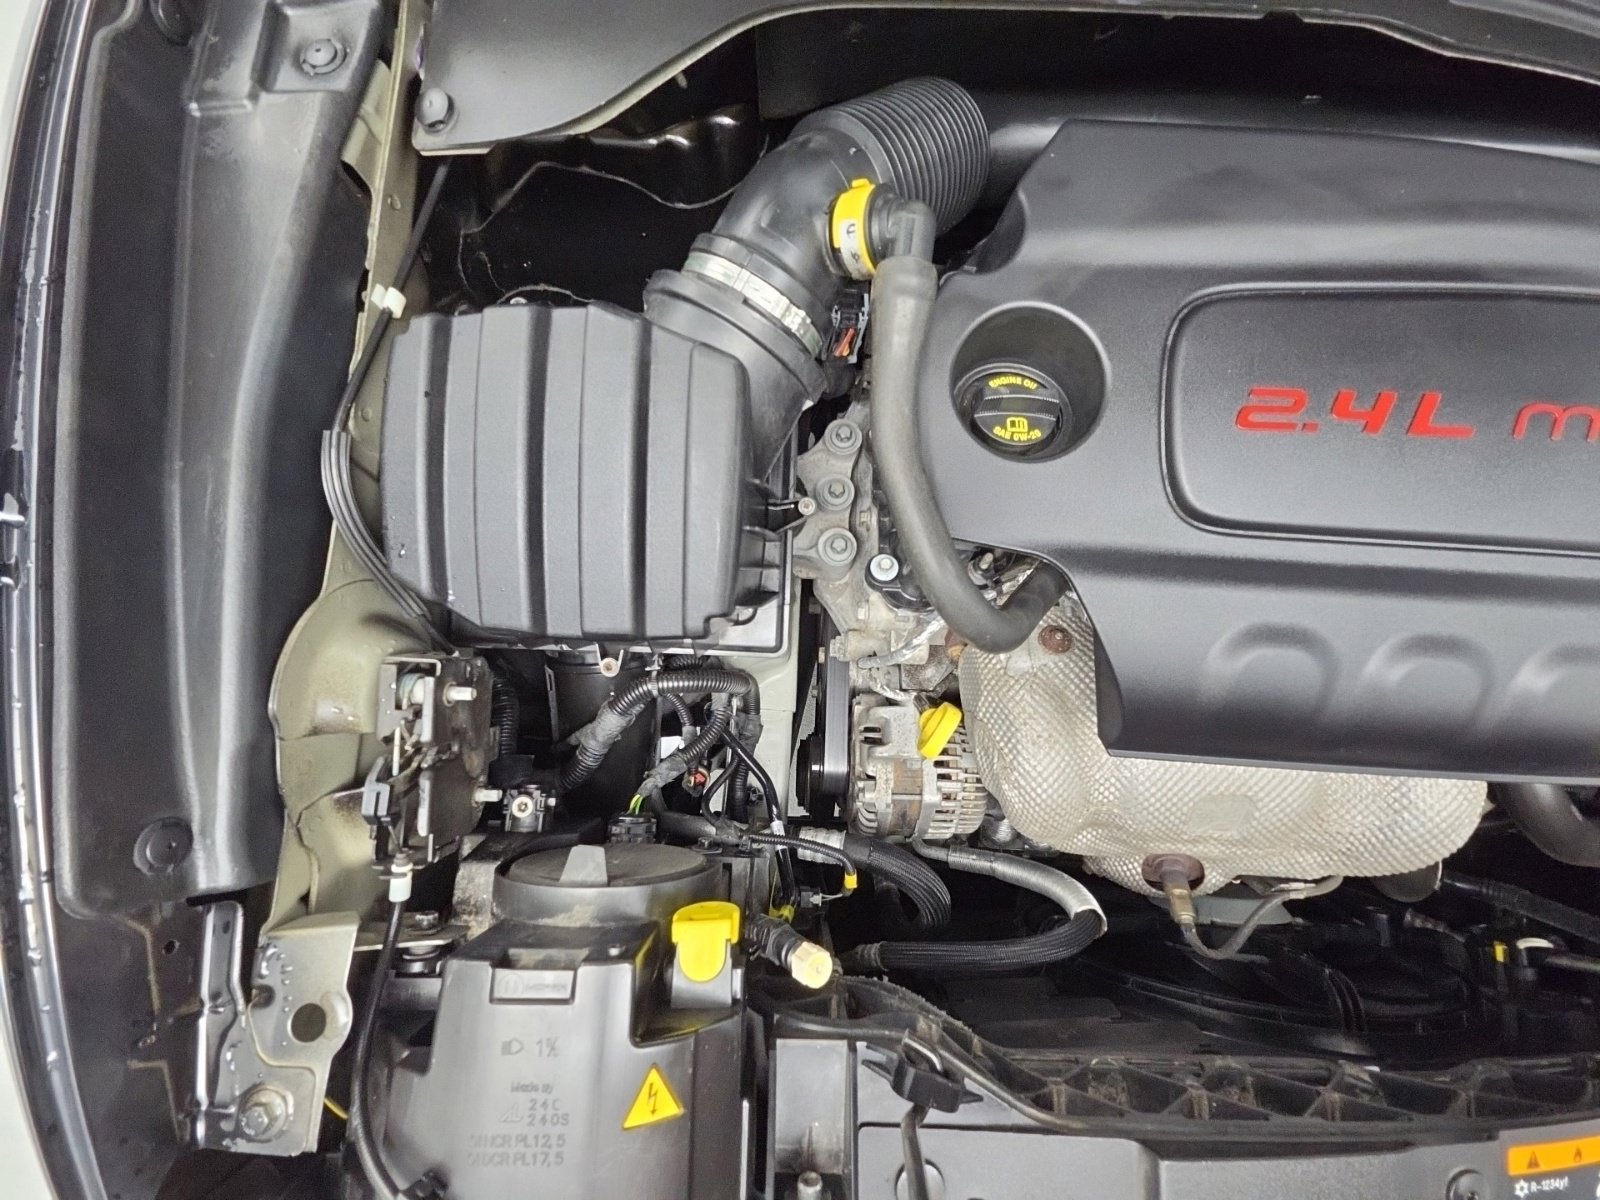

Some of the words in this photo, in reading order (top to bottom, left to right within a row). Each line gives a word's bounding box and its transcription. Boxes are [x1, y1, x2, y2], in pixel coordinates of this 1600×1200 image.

[988, 375, 1022, 388] ENGINE
[1023, 376, 1038, 390] OIL
[1234, 387, 1477, 438] 2.4L
[992, 426, 1012, 440] SAE
[1012, 428, 1042, 442] 0W-20
